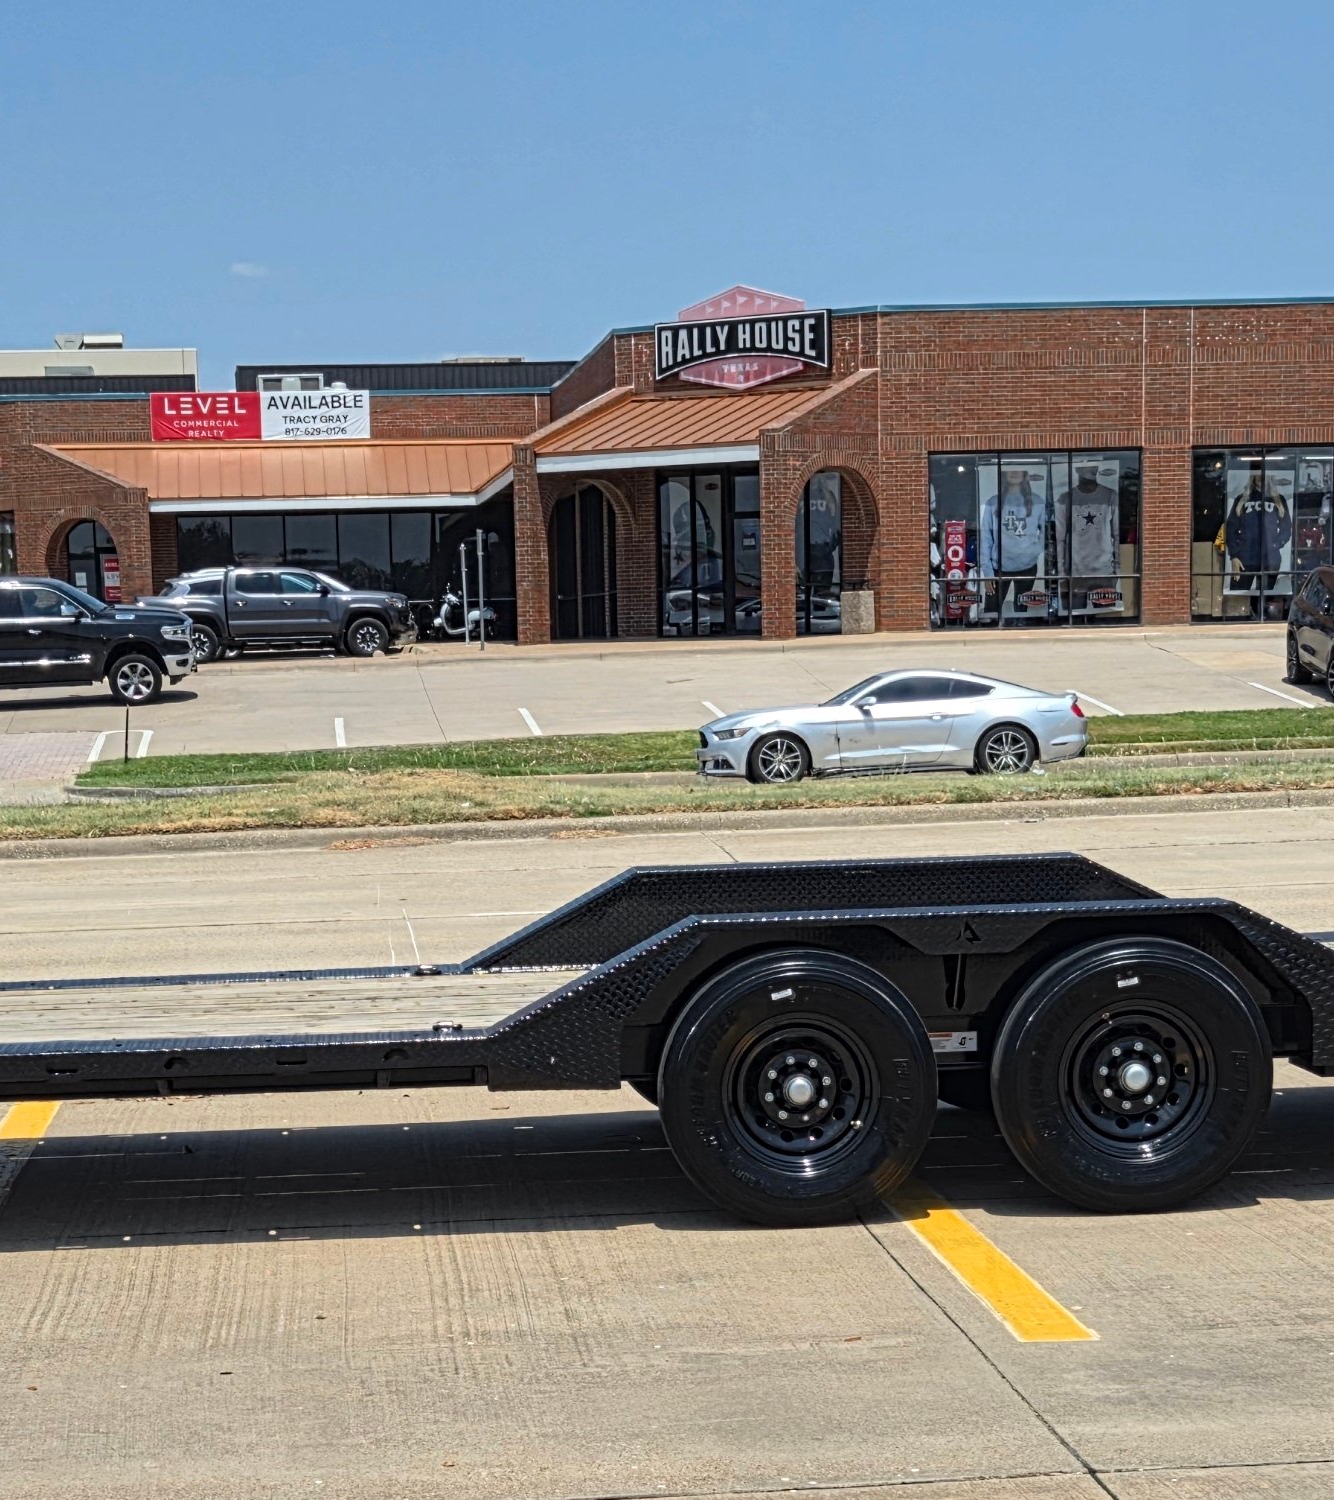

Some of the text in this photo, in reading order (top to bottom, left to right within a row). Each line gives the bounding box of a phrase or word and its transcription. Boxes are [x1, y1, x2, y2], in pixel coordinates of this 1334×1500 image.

[660, 317, 817, 369] RALLY HOUSE
[164, 396, 247, 415] LEVEL
[267, 394, 364, 410] AVAILABLE
[173, 420, 239, 428] COMMERCIAL
[282, 414, 350, 425] TRACY GRAY
[188, 430, 224, 438] REALTY
[284, 427, 348, 436] 817-629-0176
